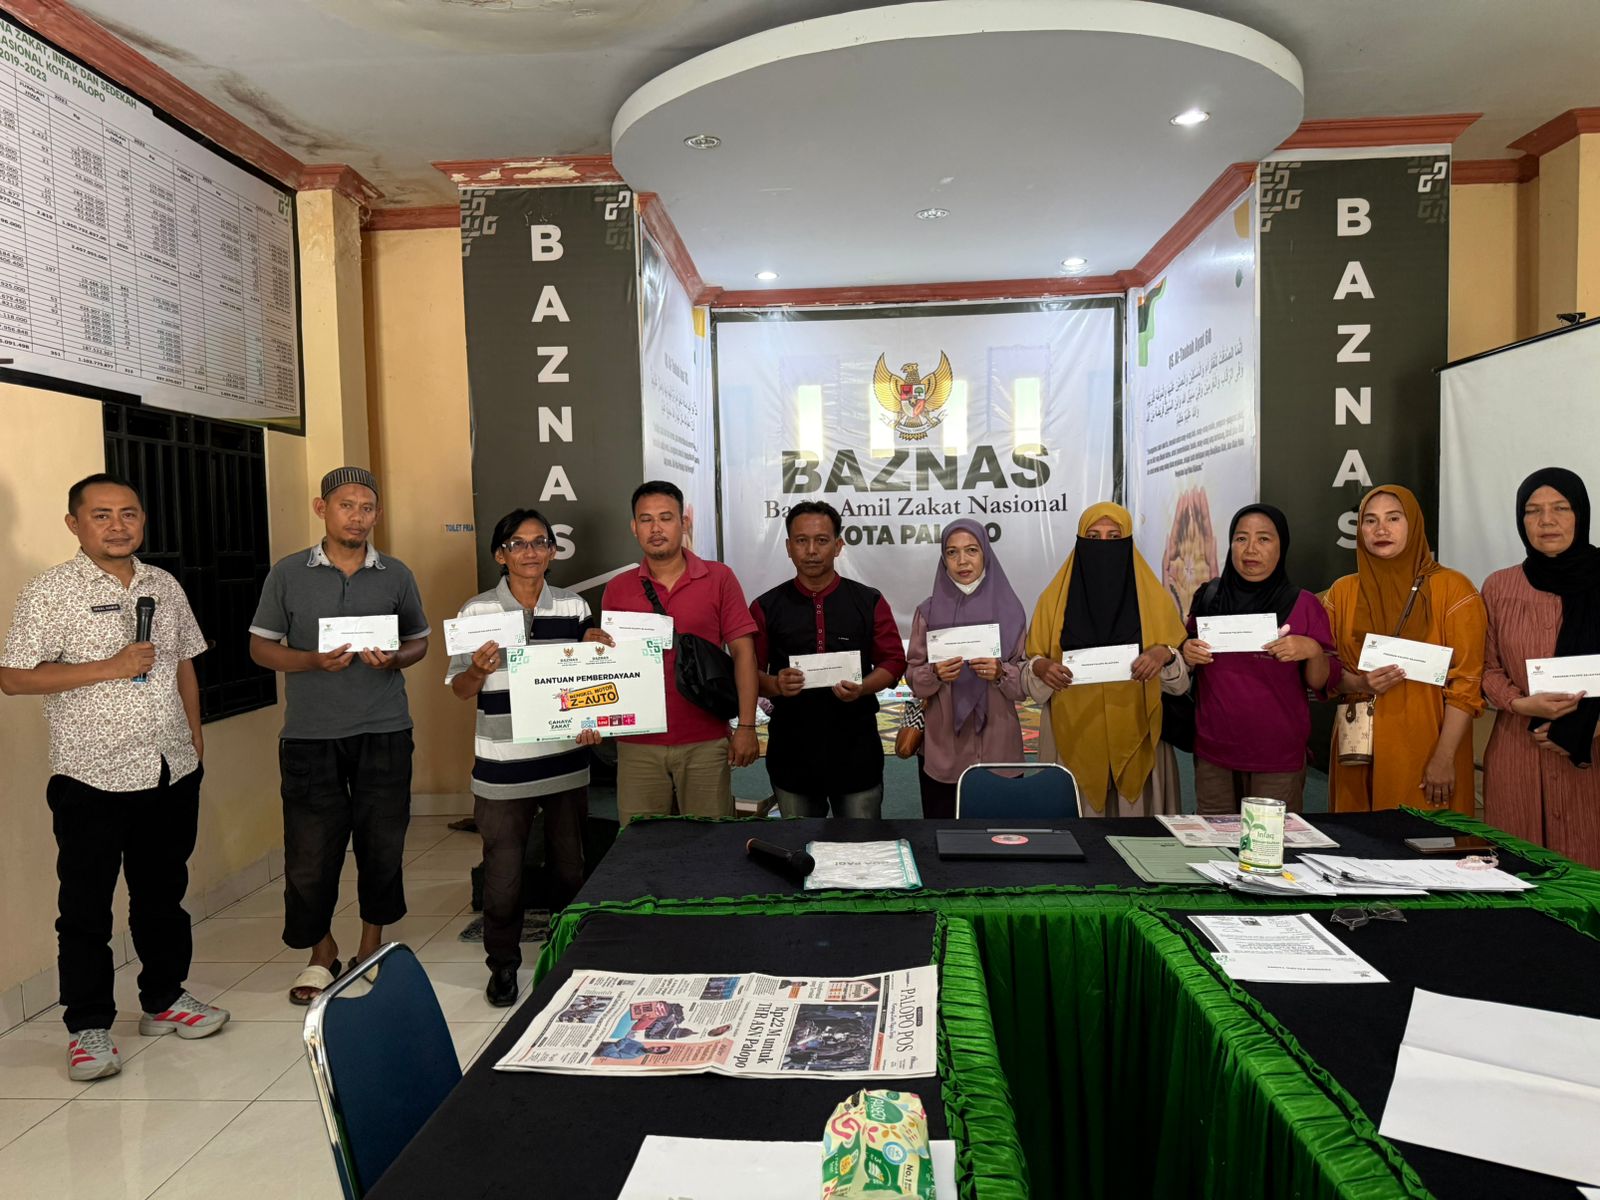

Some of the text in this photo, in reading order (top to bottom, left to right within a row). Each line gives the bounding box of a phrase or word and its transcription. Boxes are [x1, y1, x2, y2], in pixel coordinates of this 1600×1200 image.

[0, 49, 47, 82] 2019-2023
[46, 61, 70, 83] KOTA
[72, 76, 106, 102] PALOPO
[53, 52, 78, 75] INFAK
[80, 68, 99, 87] DAN
[100, 82, 137, 109] SEDEKAH
[530, 224, 578, 560] BAZNAS
[782, 444, 1051, 494] BAZNAS
[841, 493, 1068, 517] Amil Zakat Nasional
[445, 524, 462, 532] TOILET
[841, 522, 1002, 546] OTA PALO
[534, 671, 641, 685] BANTUAN PEMBERDAYAAN
[594, 684, 613, 693] MOTOR
[570, 692, 617, 707] Z-AUTO
[1257, 831, 1275, 840] Infaq
[896, 988, 916, 1053] PALOPO POS
[733, 1003, 772, 1068] THR ASN Palopo
[757, 1006, 789, 1064] Rp22 M untuk
[871, 1098, 886, 1120] PASEO
[906, 1164, 914, 1183] No.1
